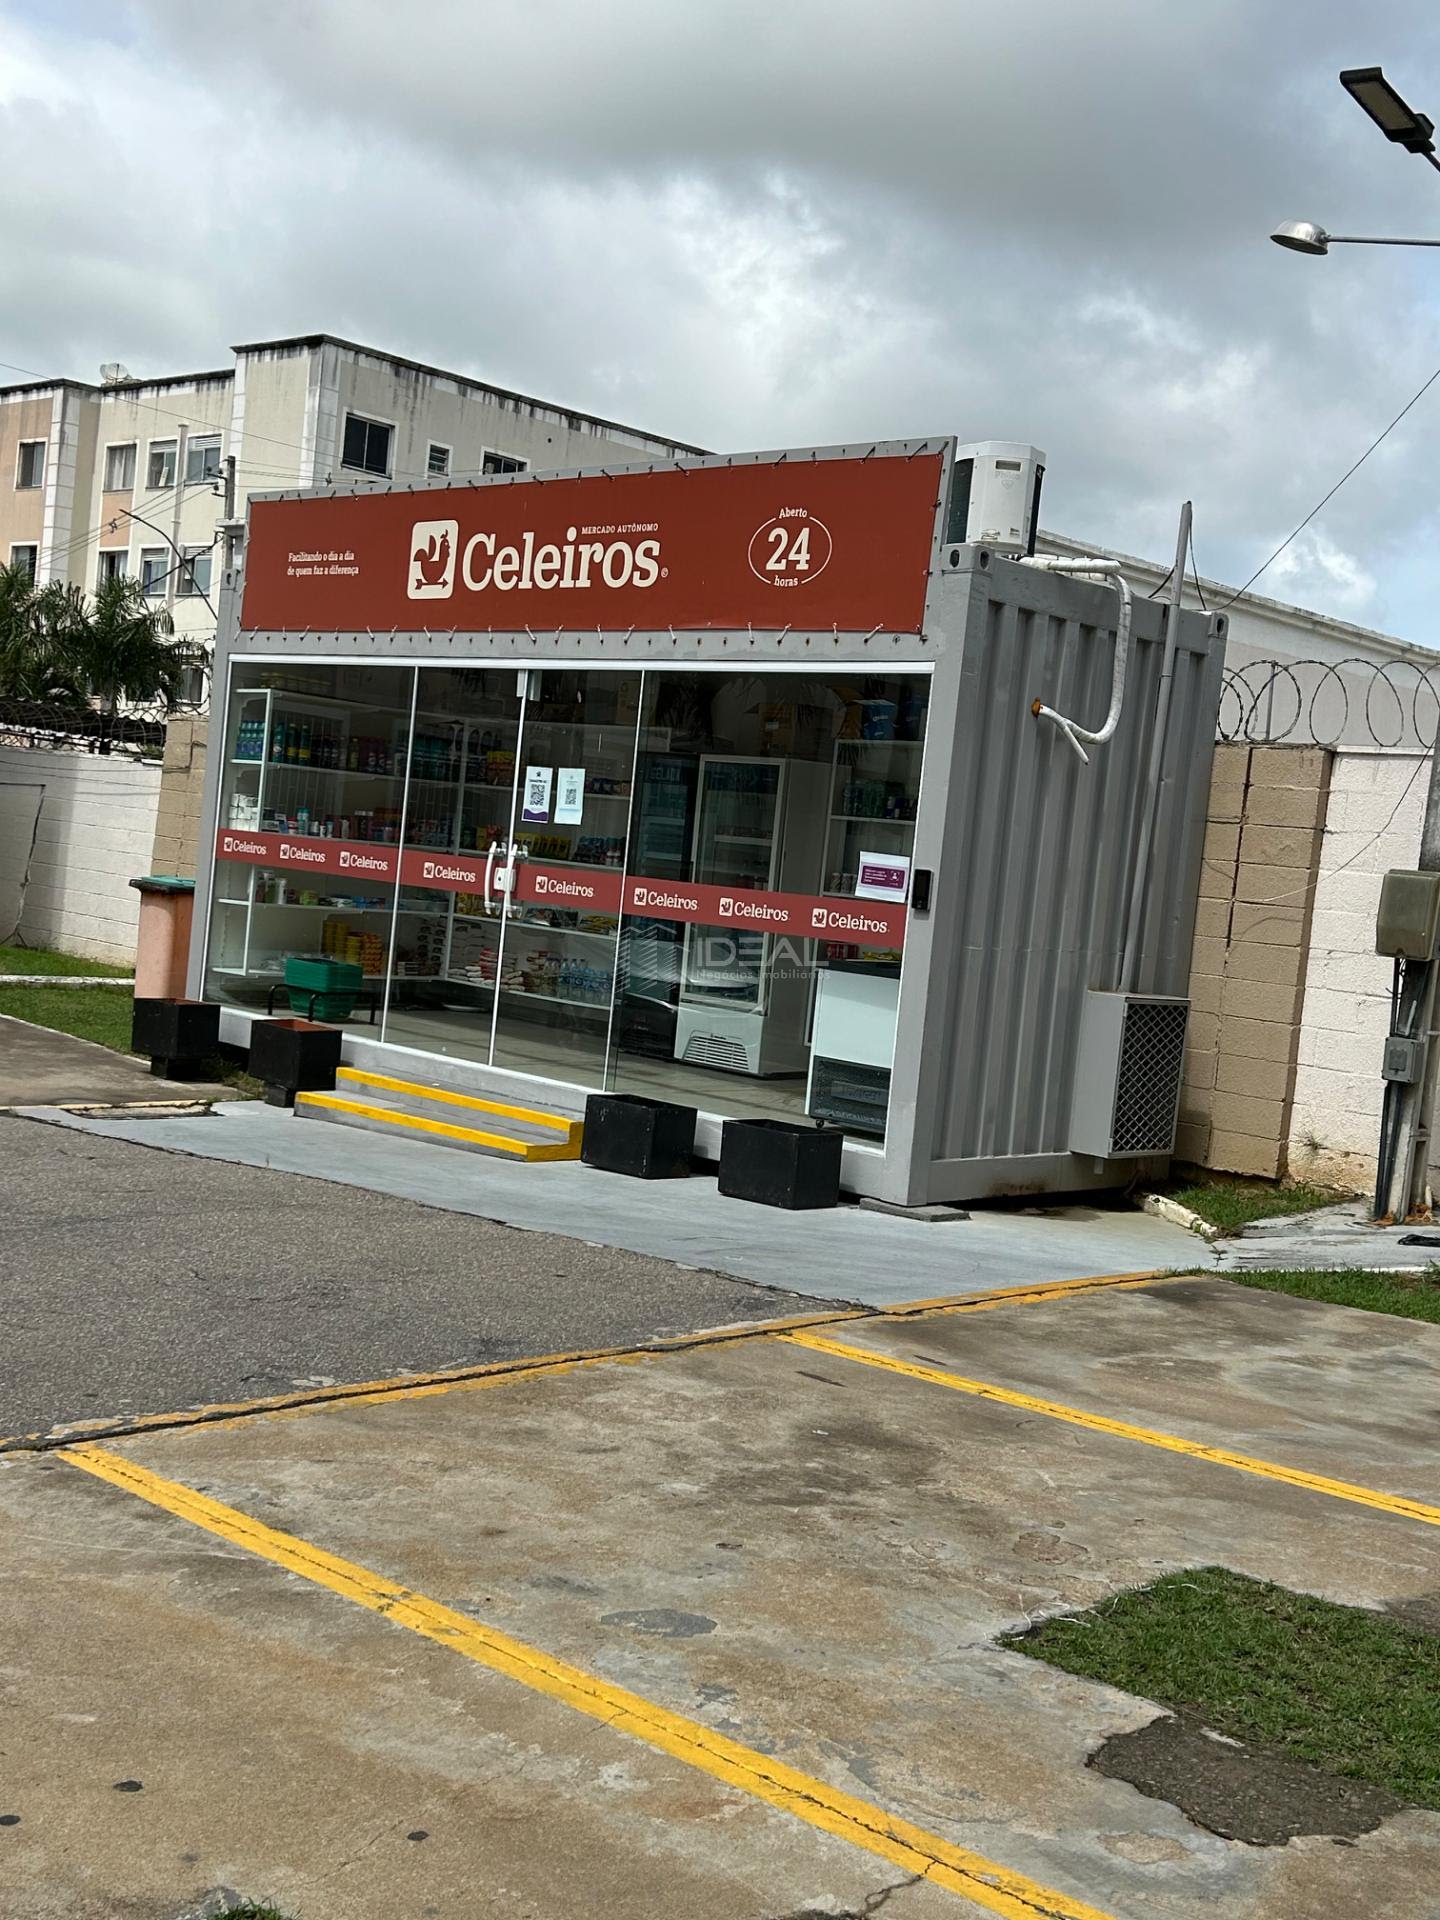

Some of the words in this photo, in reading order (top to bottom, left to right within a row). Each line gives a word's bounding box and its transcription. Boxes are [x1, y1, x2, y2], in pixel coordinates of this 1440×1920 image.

[778, 507, 808, 519] Aberto
[581, 526, 616, 534] MERCADO
[617, 523, 659, 533] AUTÔNOMO
[288, 551, 322, 562] Facilitando
[328, 551, 338, 561] dia
[344, 550, 354, 560] dia
[765, 527, 811, 571] 24
[463, 526, 661, 592] Celeiros
[287, 566, 295, 575] de
[295, 567, 313, 577] quem
[313, 565, 323, 575] faz
[329, 564, 359, 576] diferença
[774, 574, 799, 587] horas
[233, 839, 267, 855] Celeiros
[289, 847, 326, 863] Celeiros
[350, 854, 388, 871] Celeiros
[434, 865, 476, 883] Celeiros
[548, 879, 594, 898] Celeiros
[648, 890, 698, 911] Celeiros
[734, 901, 789, 922] Celeiros
[828, 912, 888, 933] Celeiros
